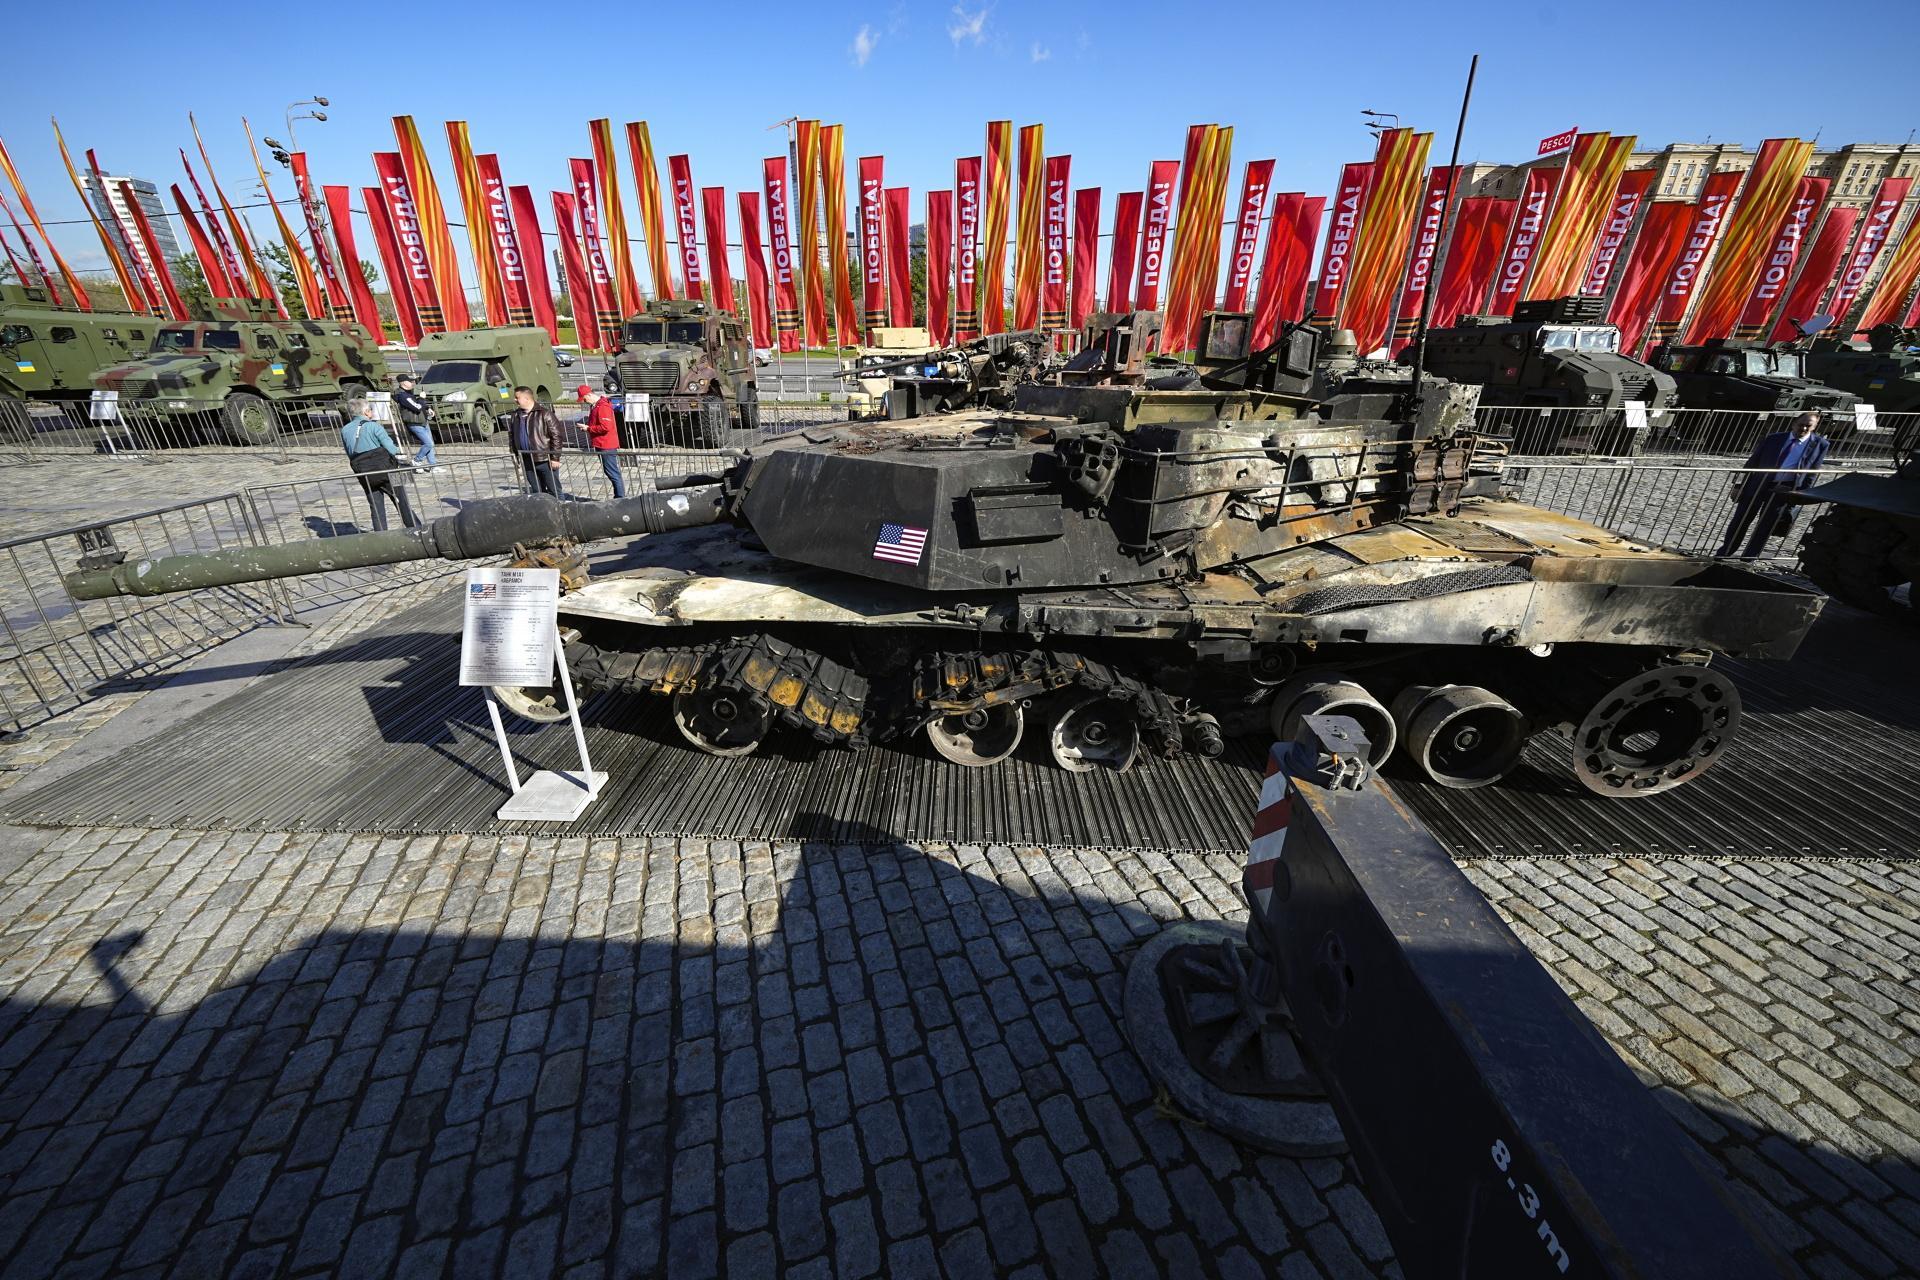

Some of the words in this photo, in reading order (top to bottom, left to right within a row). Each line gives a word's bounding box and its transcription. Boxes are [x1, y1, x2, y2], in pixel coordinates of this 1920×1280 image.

[1540, 134, 1571, 152] PESCO
[387, 177, 428, 279] ПОБЕДА!
[486, 177, 524, 282] ПОБЕДА!
[578, 182, 608, 284] ПОБЕДА!
[676, 179, 701, 282] ПОБЕДА!
[769, 179, 790, 283] ПОБЕДА!
[863, 179, 881, 283] ПОБЕДА!
[961, 181, 976, 283] ПОБЕДА!
[1048, 180, 1064, 283] ПОБЕДА!
[1144, 182, 1170, 286] ПОБЕДА!
[1234, 184, 1264, 287] ПОБЕДА!
[1324, 187, 1361, 289] ПОБЕДА!
[1410, 189, 1447, 292] ПОБЕДА!
[1500, 191, 1547, 293] ПОБЕДА!
[1586, 193, 1639, 294] ПОБЕДА!
[1670, 194, 1728, 295] ПОБЕДА!
[1758, 199, 1815, 298] ПОБЕДА!
[1838, 200, 1898, 299] ПОБЕДА!
